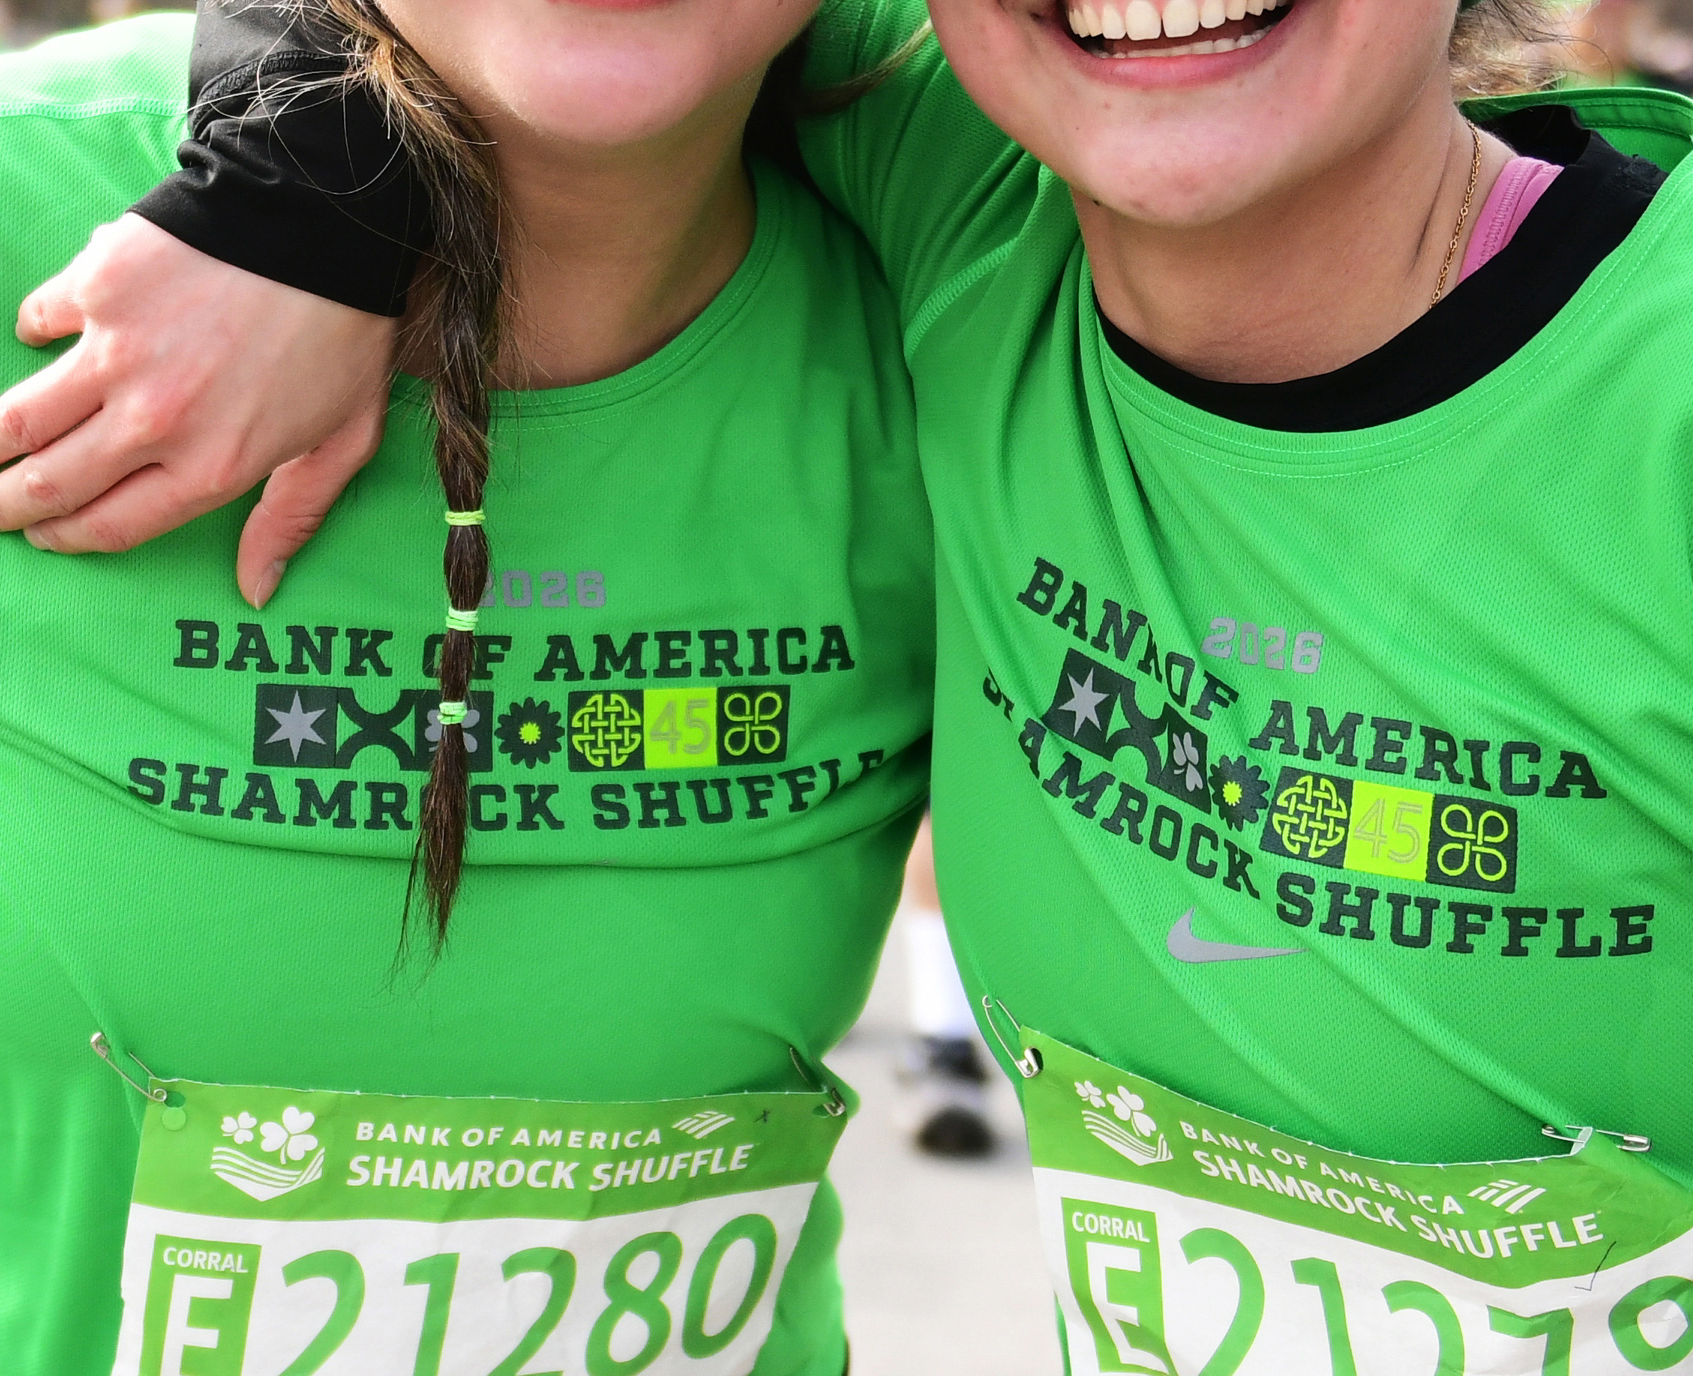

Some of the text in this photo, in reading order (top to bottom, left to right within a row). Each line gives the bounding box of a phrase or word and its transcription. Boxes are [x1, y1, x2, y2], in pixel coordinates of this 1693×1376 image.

[478, 570, 606, 608] 026
[173, 619, 393, 677] BANK
[533, 625, 855, 682] AMERICA
[1200, 617, 1324, 674] 2026
[649, 698, 711, 755] 45
[1165, 651, 1239, 721] OF
[1250, 700, 1607, 799] AMERICA
[126, 757, 565, 831] SHAMRCK
[1354, 798, 1422, 865] 45
[1276, 871, 1654, 958] SHUFFLE
[347, 1144, 754, 1192] SHAMROCK SHUFFLE
[355, 1122, 662, 1151] BANK OF AMERICA
[1179, 1120, 1465, 1215] BANK OF AMERICA
[1072, 1211, 1150, 1243] CORRAL
[1192, 1150, 1604, 1259] SHAMROCK SHUFFLE
[163, 1246, 248, 1273] CORRAL
[1086, 1241, 1169, 1374] E
